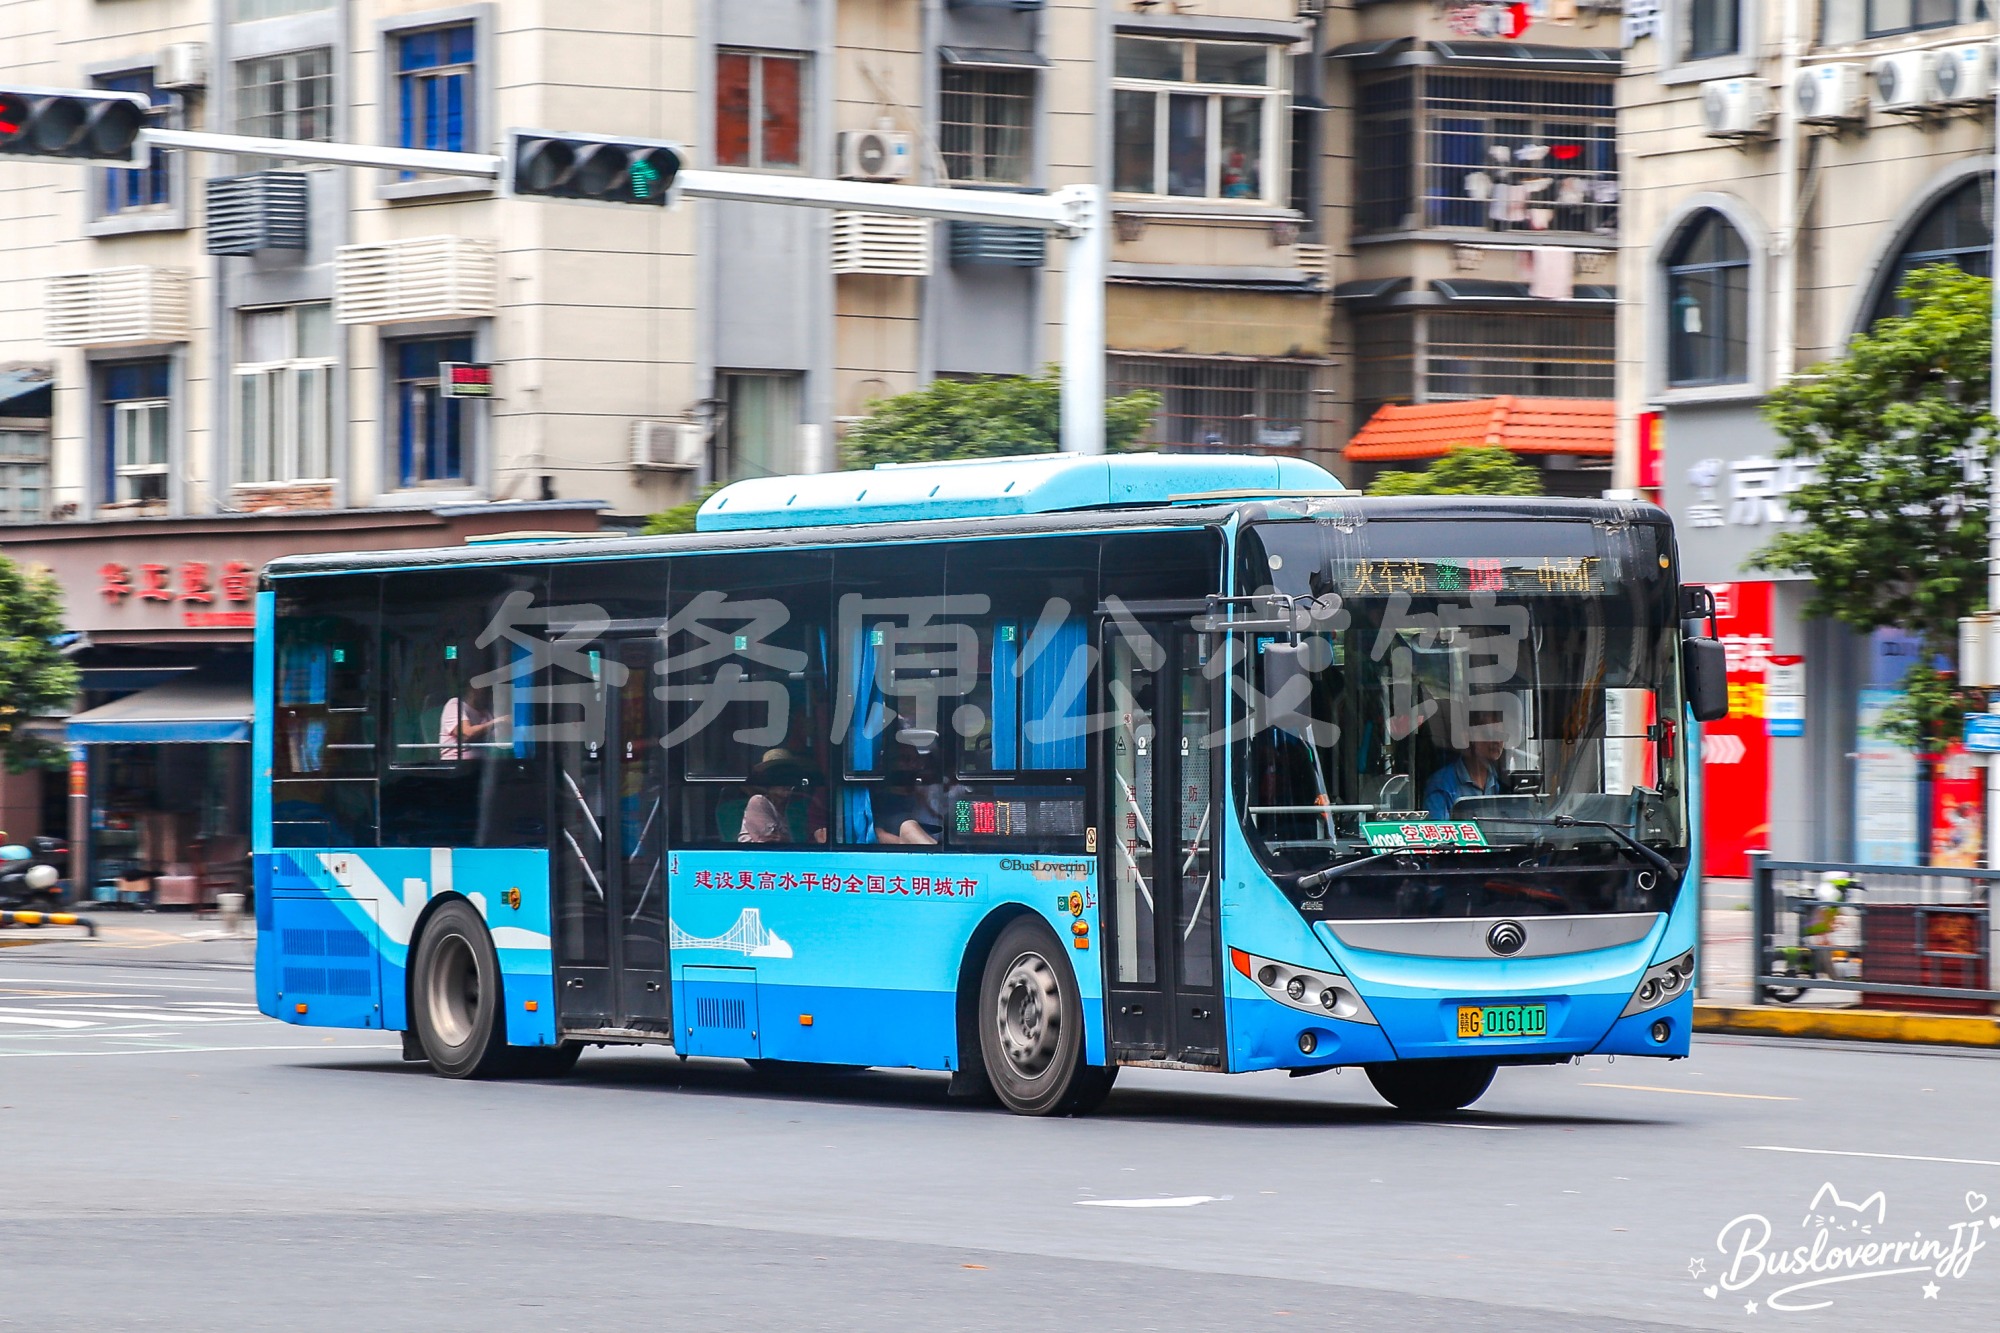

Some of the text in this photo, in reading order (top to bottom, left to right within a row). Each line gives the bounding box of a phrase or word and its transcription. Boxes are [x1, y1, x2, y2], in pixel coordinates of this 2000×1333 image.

[1355, 557, 1427, 594] 火车站
[1466, 558, 1504, 591] 108
[1125, 784, 1139, 884] 注意开门
[1400, 824, 1481, 842] 空调开启
[694, 869, 978, 898] 建设更高水平的全国文明城市
[1487, 1009, 1545, 1032] 01611D
